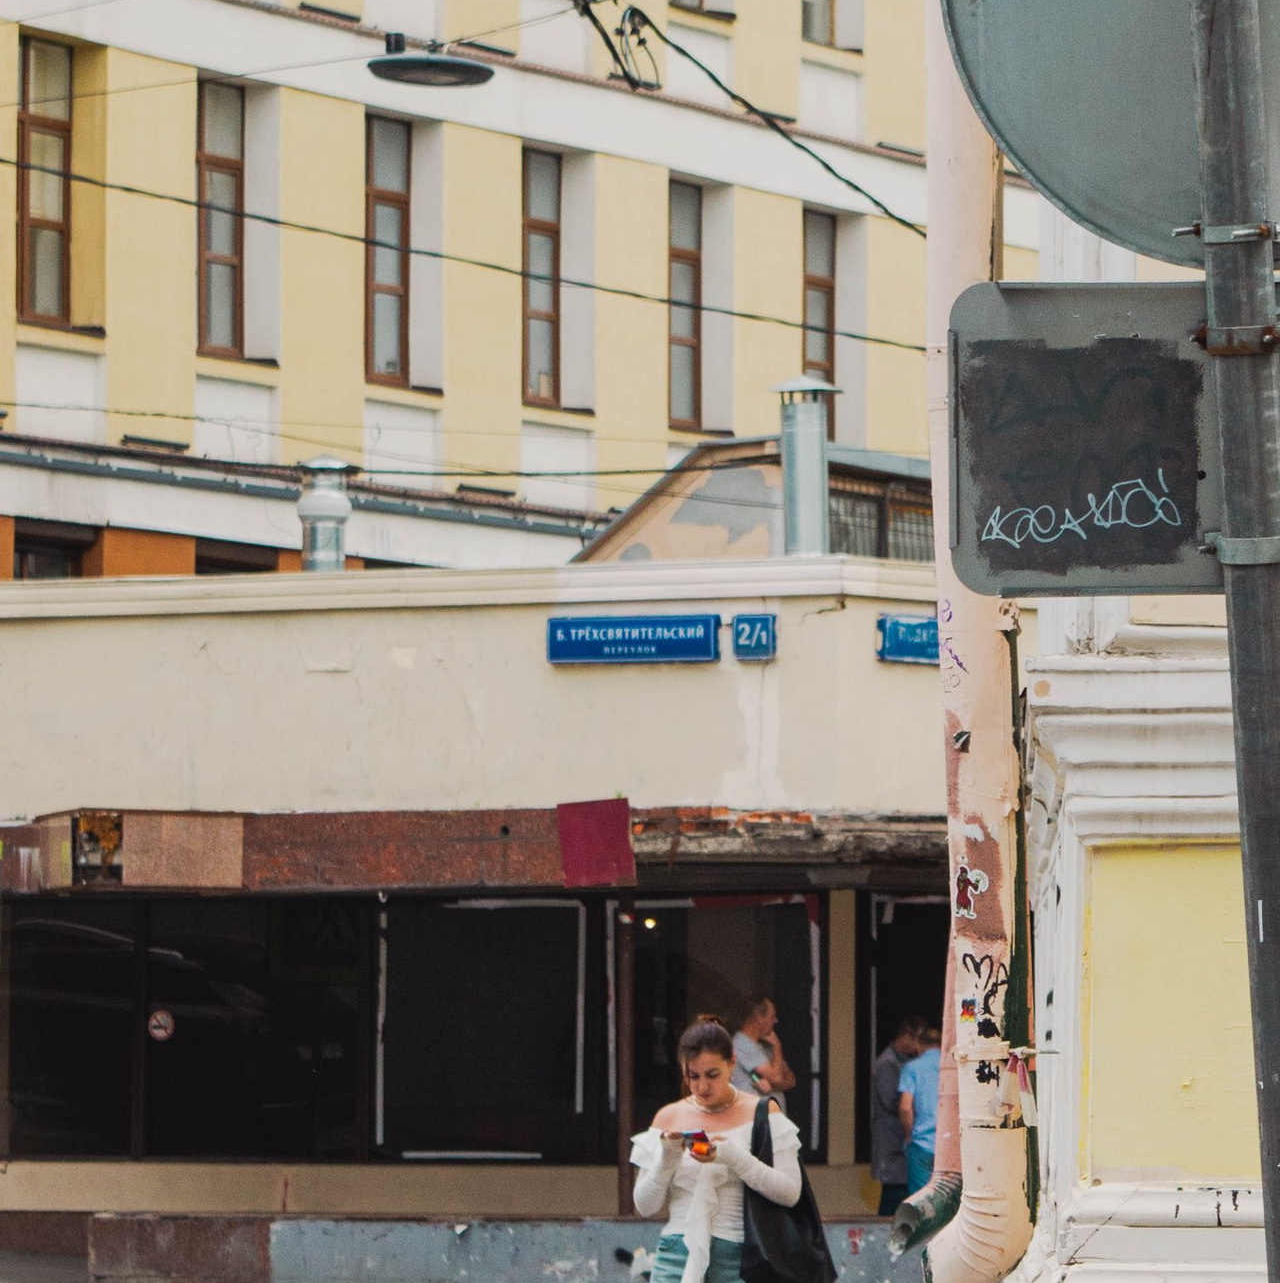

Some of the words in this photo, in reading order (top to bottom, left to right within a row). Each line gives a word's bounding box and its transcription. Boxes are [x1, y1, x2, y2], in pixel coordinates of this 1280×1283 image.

[556, 629, 568, 642] Б.
[570, 624, 705, 640] ТРЁХСВЯТИТЕЛЬСКИЙ
[738, 622, 768, 647] 2/1
[603, 646, 658, 655] ПЕРЕУЛОК
